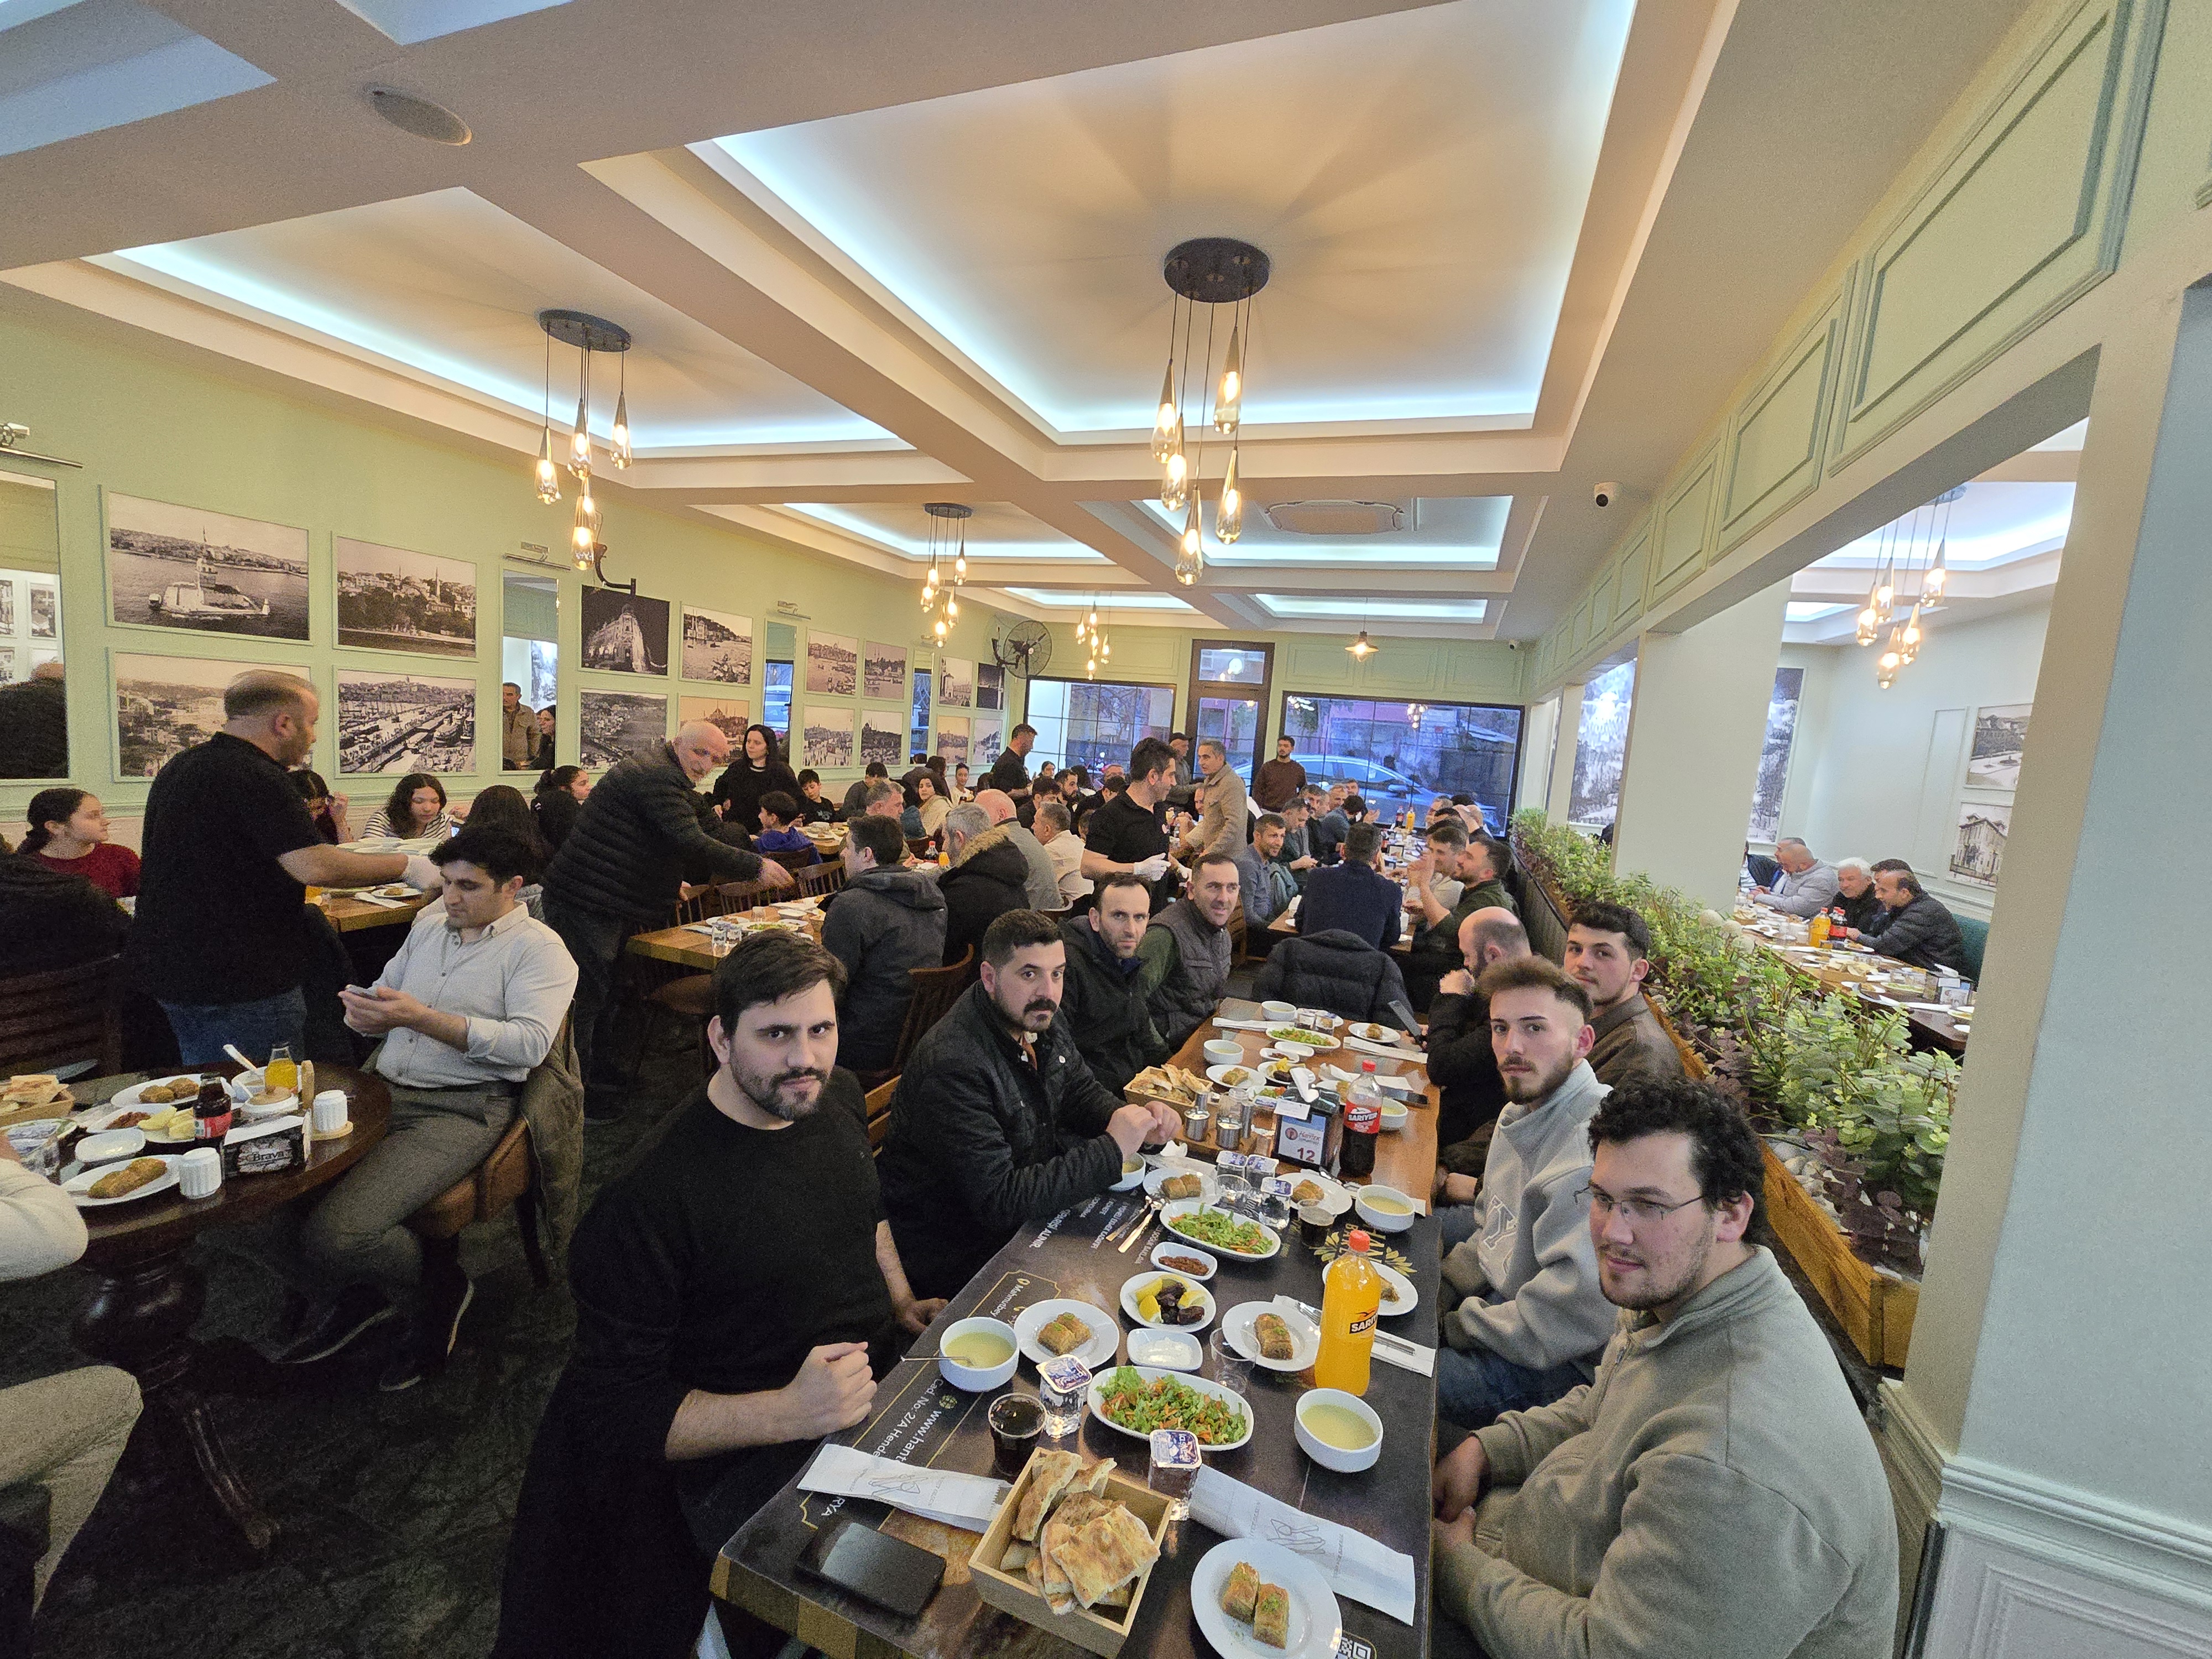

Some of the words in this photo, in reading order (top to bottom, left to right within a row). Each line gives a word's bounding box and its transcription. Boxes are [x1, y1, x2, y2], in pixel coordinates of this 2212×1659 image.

[1297, 1147, 1315, 1162] 12
[990, 1285, 1024, 1317] Mahmutbey
[924, 1379, 944, 1396] Cad.
[911, 1396, 930, 1412] No:
[897, 1411, 916, 1427] 2/A
[872, 1428, 902, 1457] Hende
[895, 1411, 942, 1462] www.hant
[821, 1496, 846, 1516] RYA
